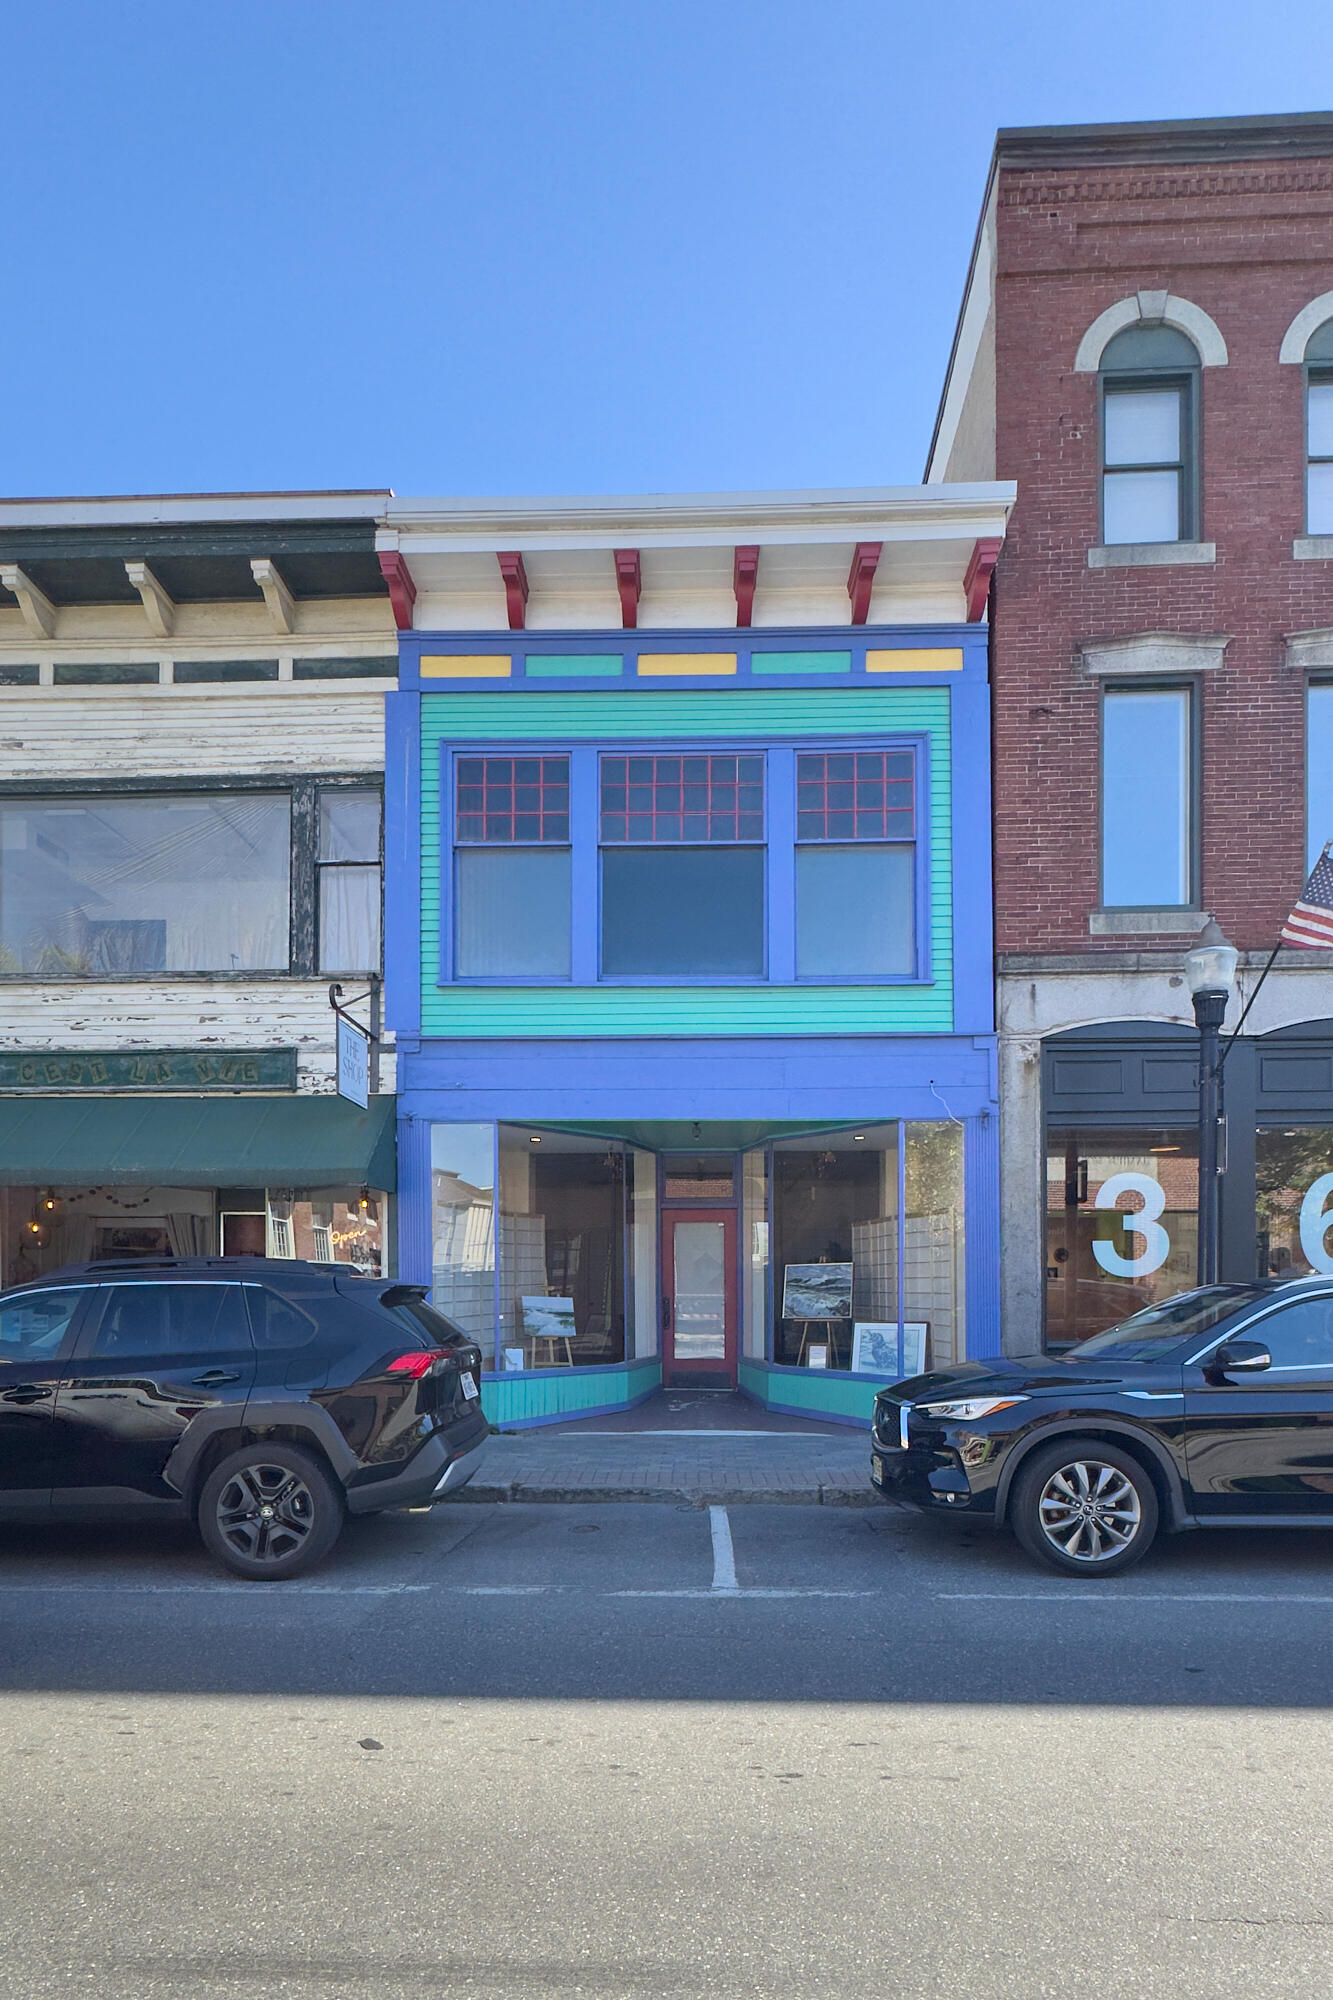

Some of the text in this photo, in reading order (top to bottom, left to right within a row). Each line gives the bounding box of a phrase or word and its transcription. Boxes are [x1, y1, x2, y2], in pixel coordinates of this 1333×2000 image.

[345, 1035, 361, 1063] THE
[133, 1058, 171, 1081] LA
[197, 1061, 256, 1080] VIE
[343, 1057, 366, 1085] SHOP
[330, 1230, 367, 1248] Open
[1092, 1173, 1170, 1278] 3
